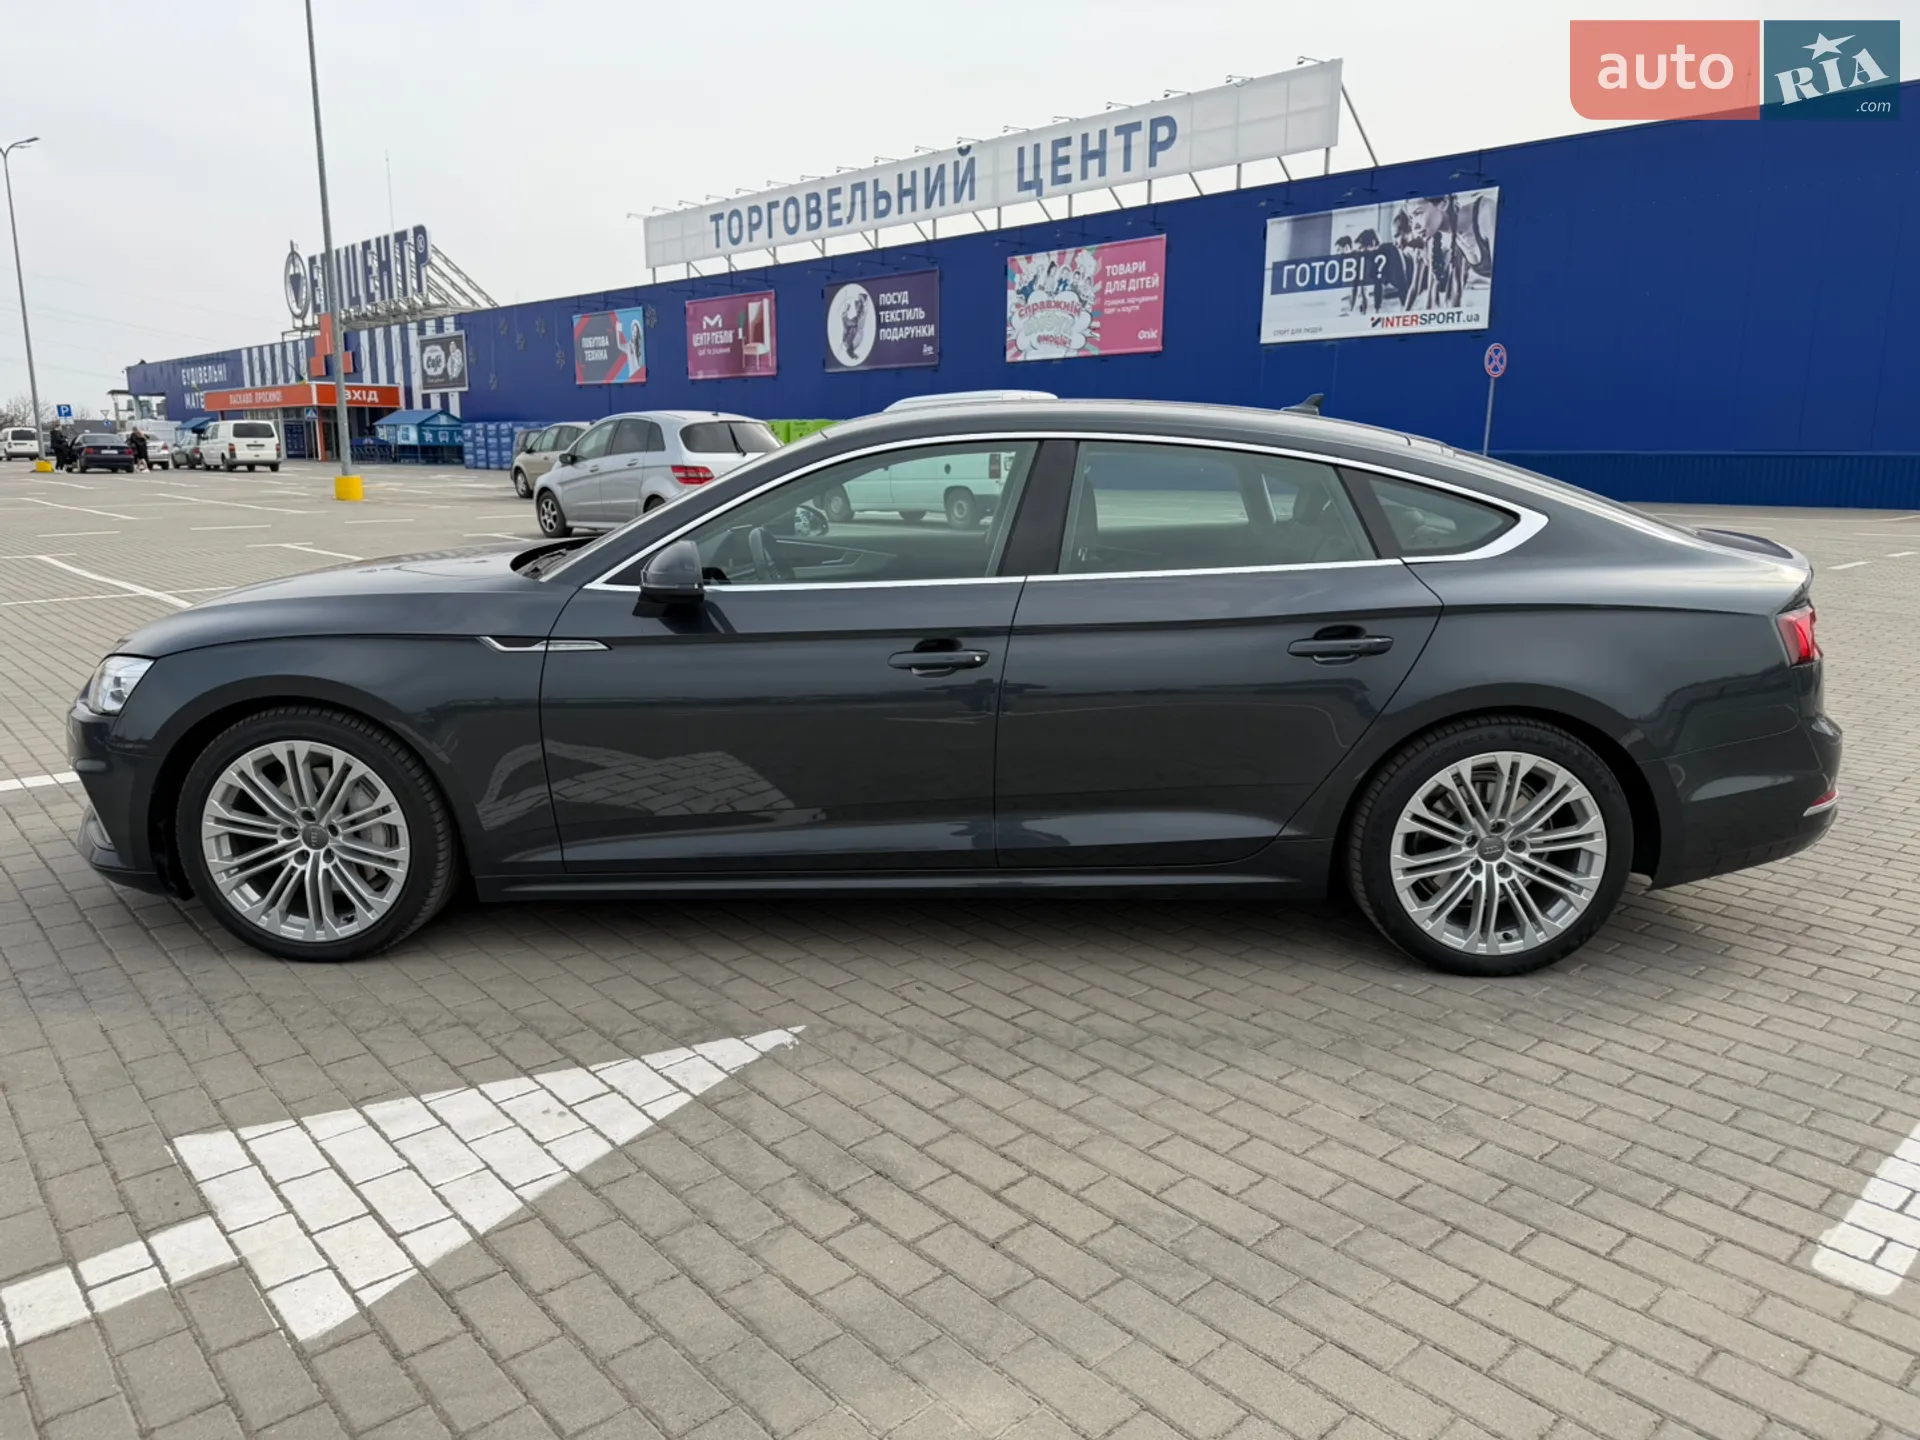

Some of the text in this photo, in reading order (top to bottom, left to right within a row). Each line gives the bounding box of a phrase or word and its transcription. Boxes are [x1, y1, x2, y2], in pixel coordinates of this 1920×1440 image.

[709, 115, 1178, 249] ТОРГОВЕЛЬНИЙ ЦЕНТР
[1105, 261, 1146, 277] ТОВАРИ
[1282, 254, 1387, 288] ГОТОВІ ?
[1104, 274, 1159, 295] ДЛЯ ДІТЕЙ
[879, 291, 909, 305] ПОСУД
[879, 307, 925, 323] ТЕКСТИЛЬ
[1381, 311, 1480, 328] INTERSPORT.ua
[880, 324, 935, 342] ПОДАРУНКИ
[181, 363, 227, 386] БУДІВЕЛЬНІ
